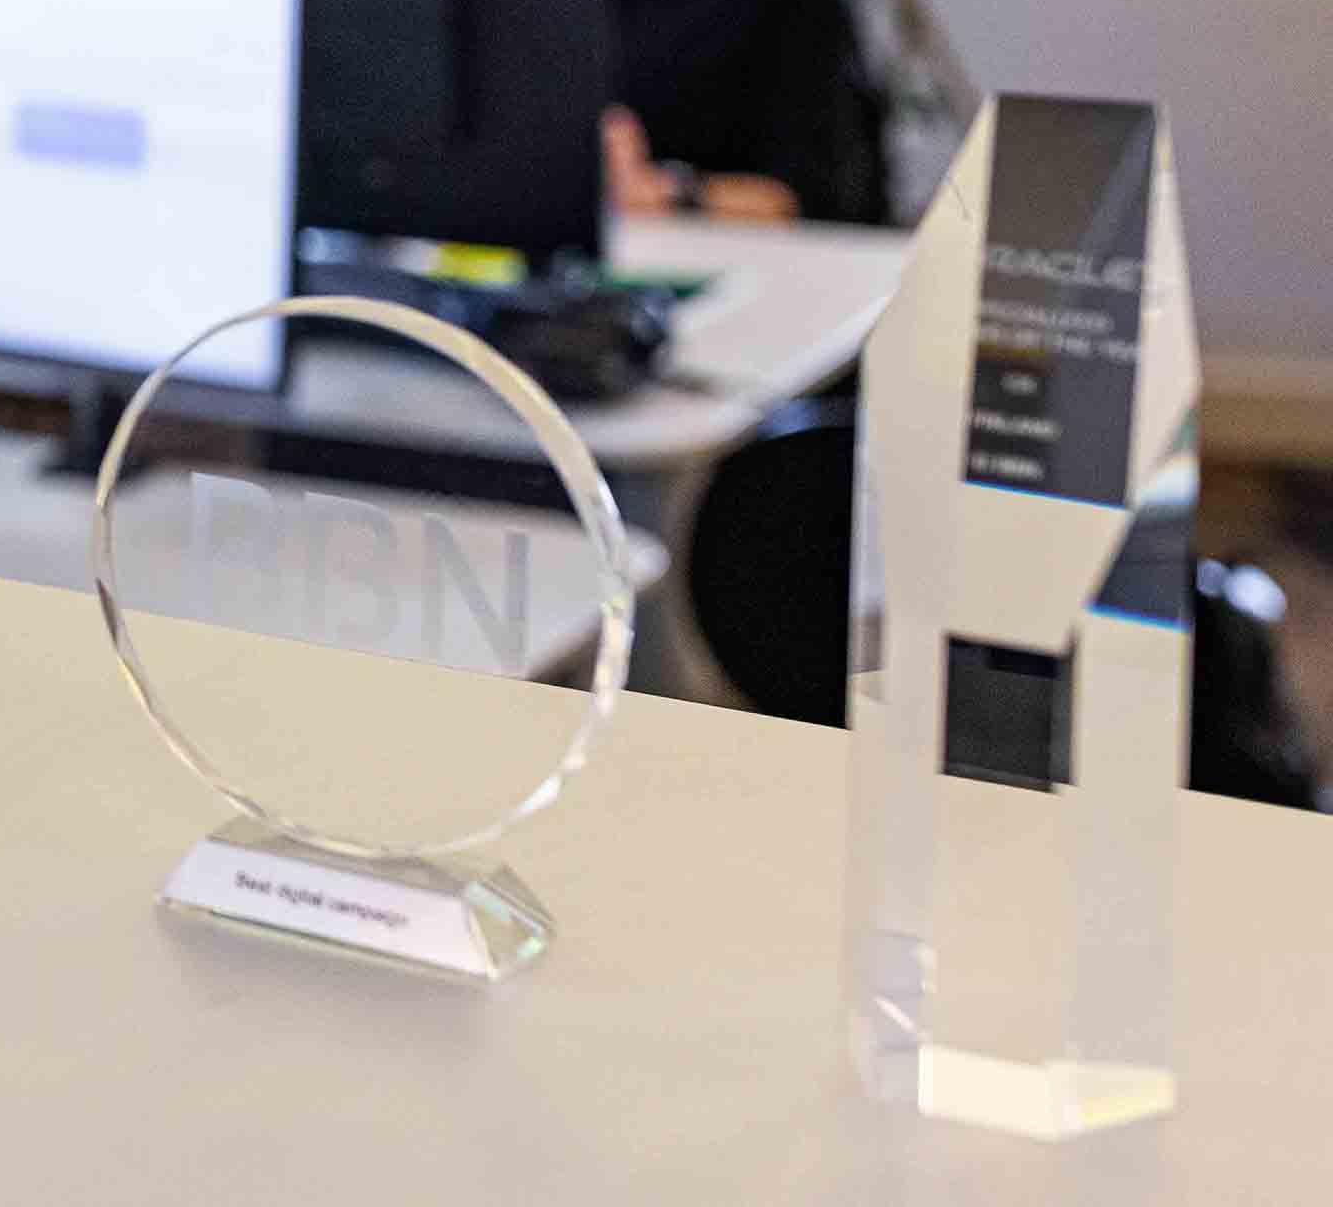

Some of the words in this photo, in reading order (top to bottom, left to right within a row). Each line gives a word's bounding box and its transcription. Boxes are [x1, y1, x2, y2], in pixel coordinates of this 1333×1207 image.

[190, 470, 532, 679] BBN
[236, 871, 271, 894] Best
[277, 884, 323, 907] digital
